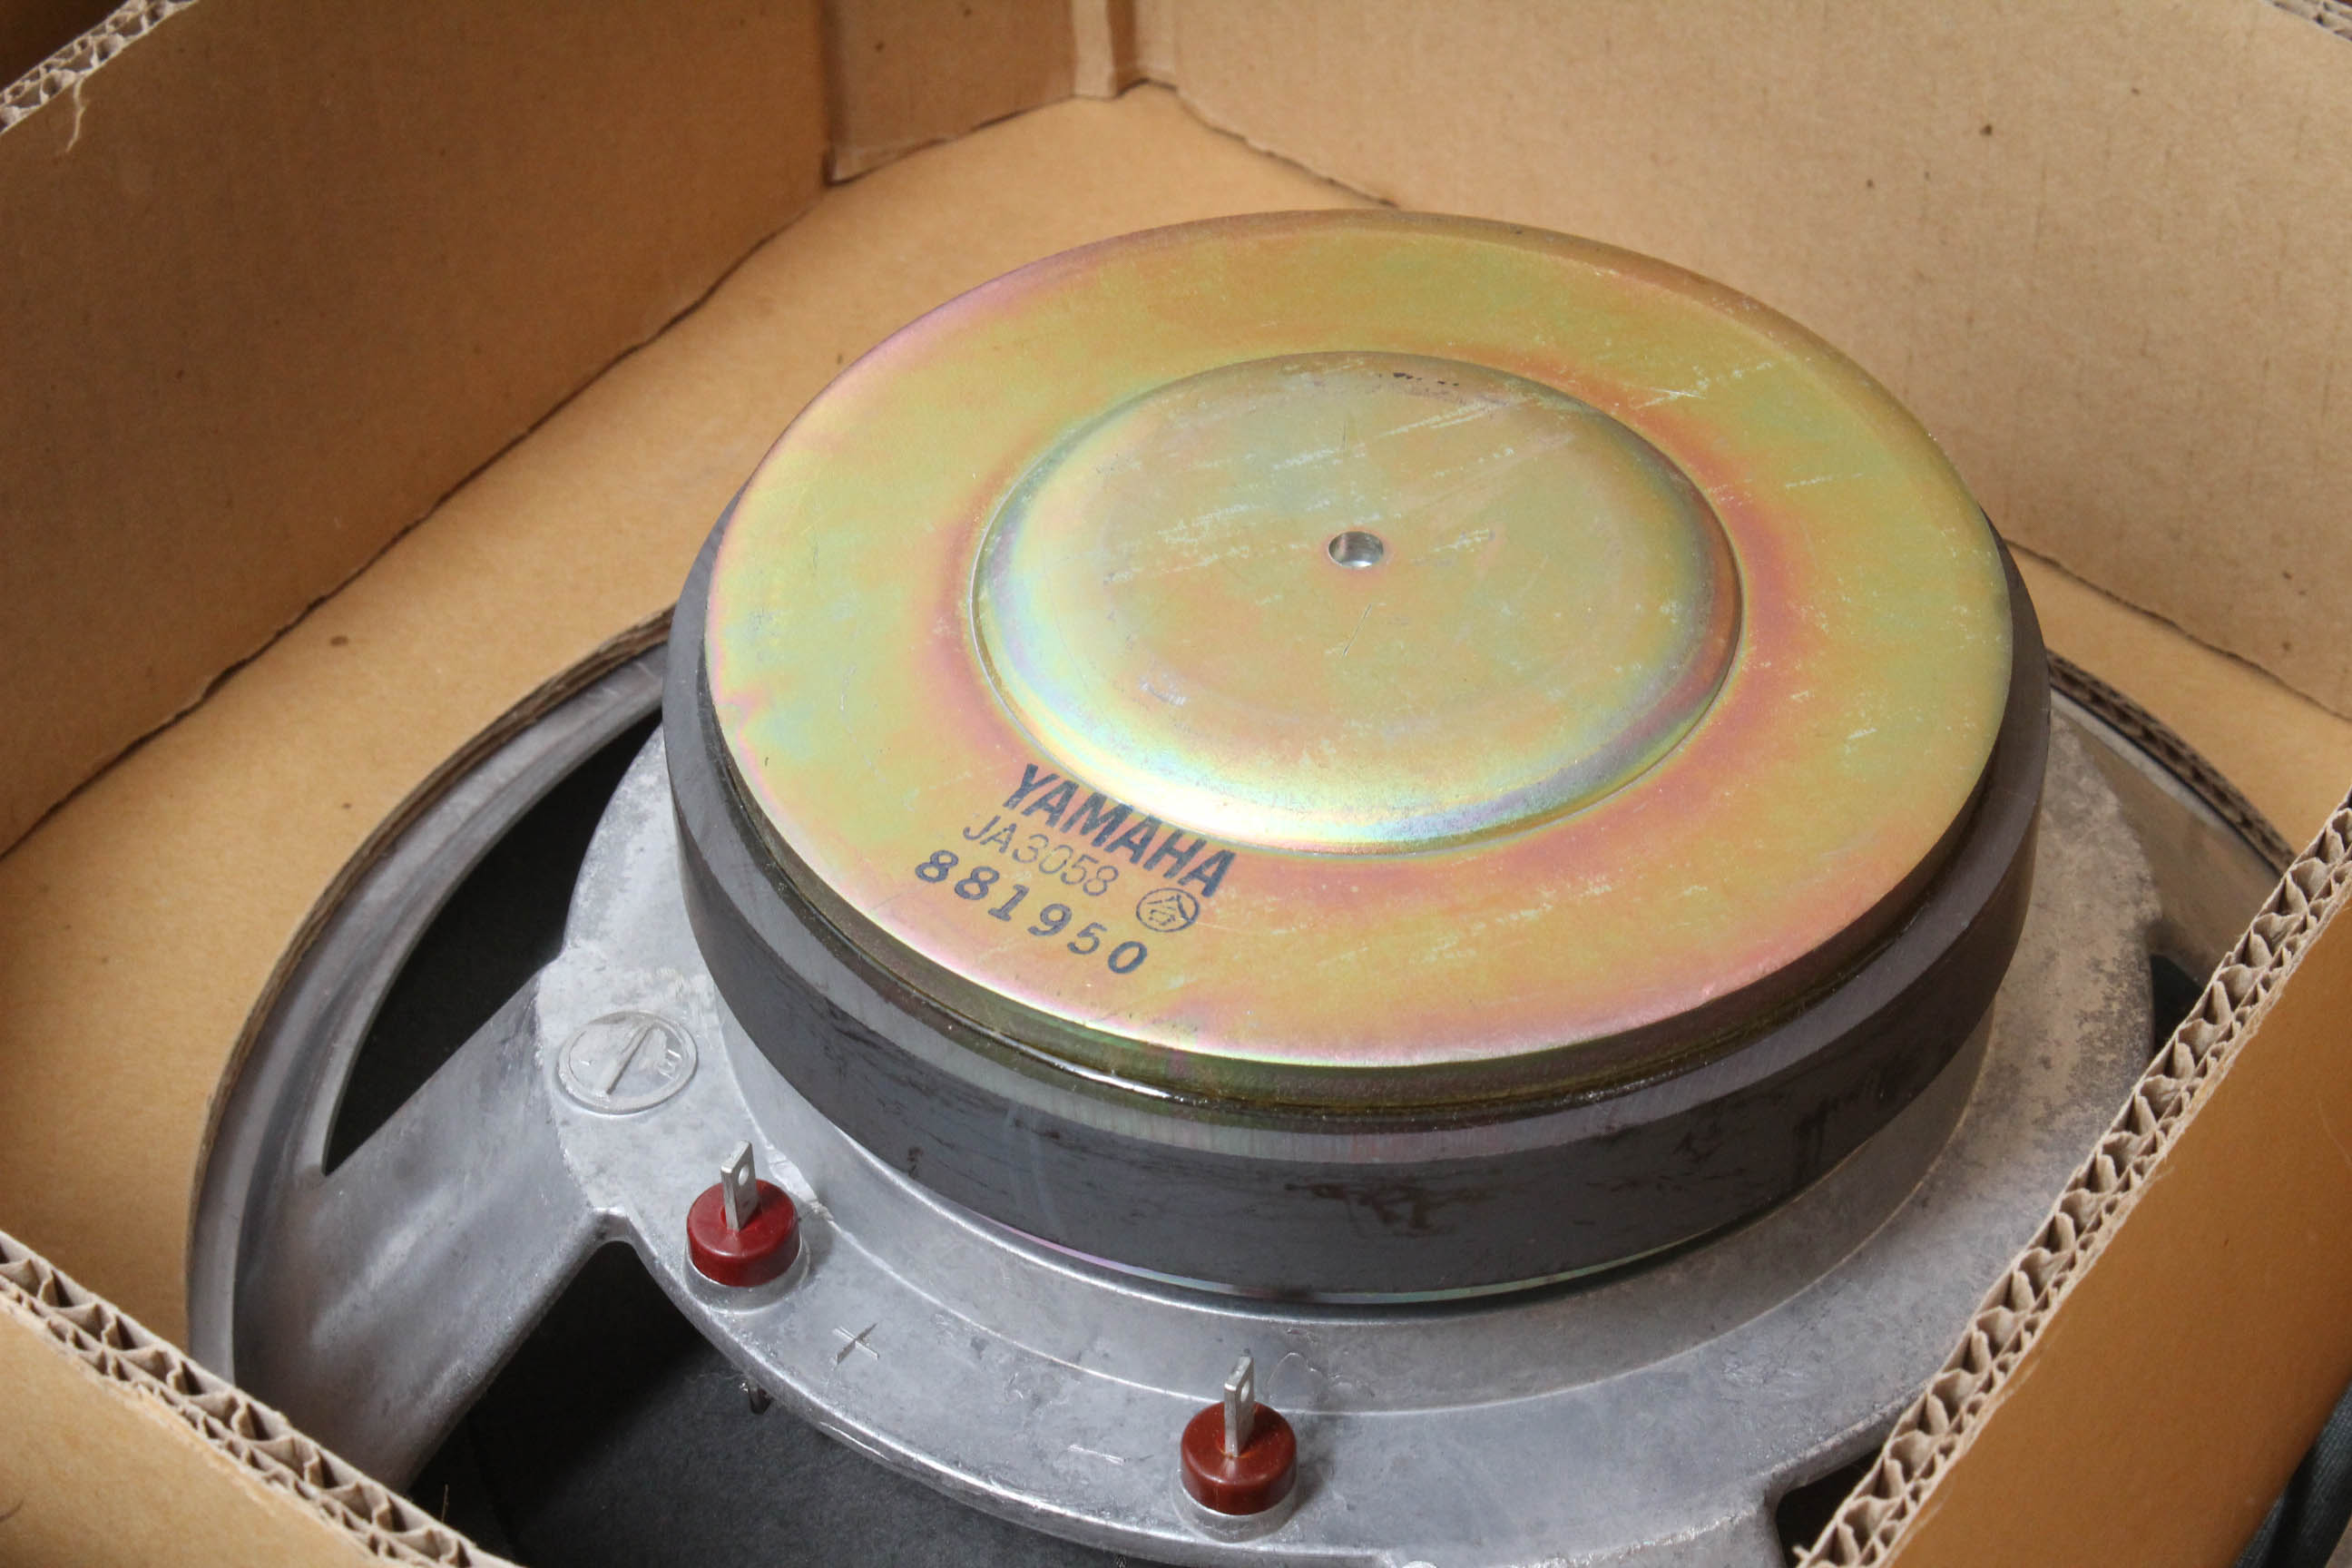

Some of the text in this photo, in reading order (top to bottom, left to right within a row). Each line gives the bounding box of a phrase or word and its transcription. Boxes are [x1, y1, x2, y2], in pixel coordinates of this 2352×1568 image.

[963, 815, 1119, 897] JA3058
[1003, 763, 1237, 898] YAMAHA
[915, 849, 1148, 974] 881950
